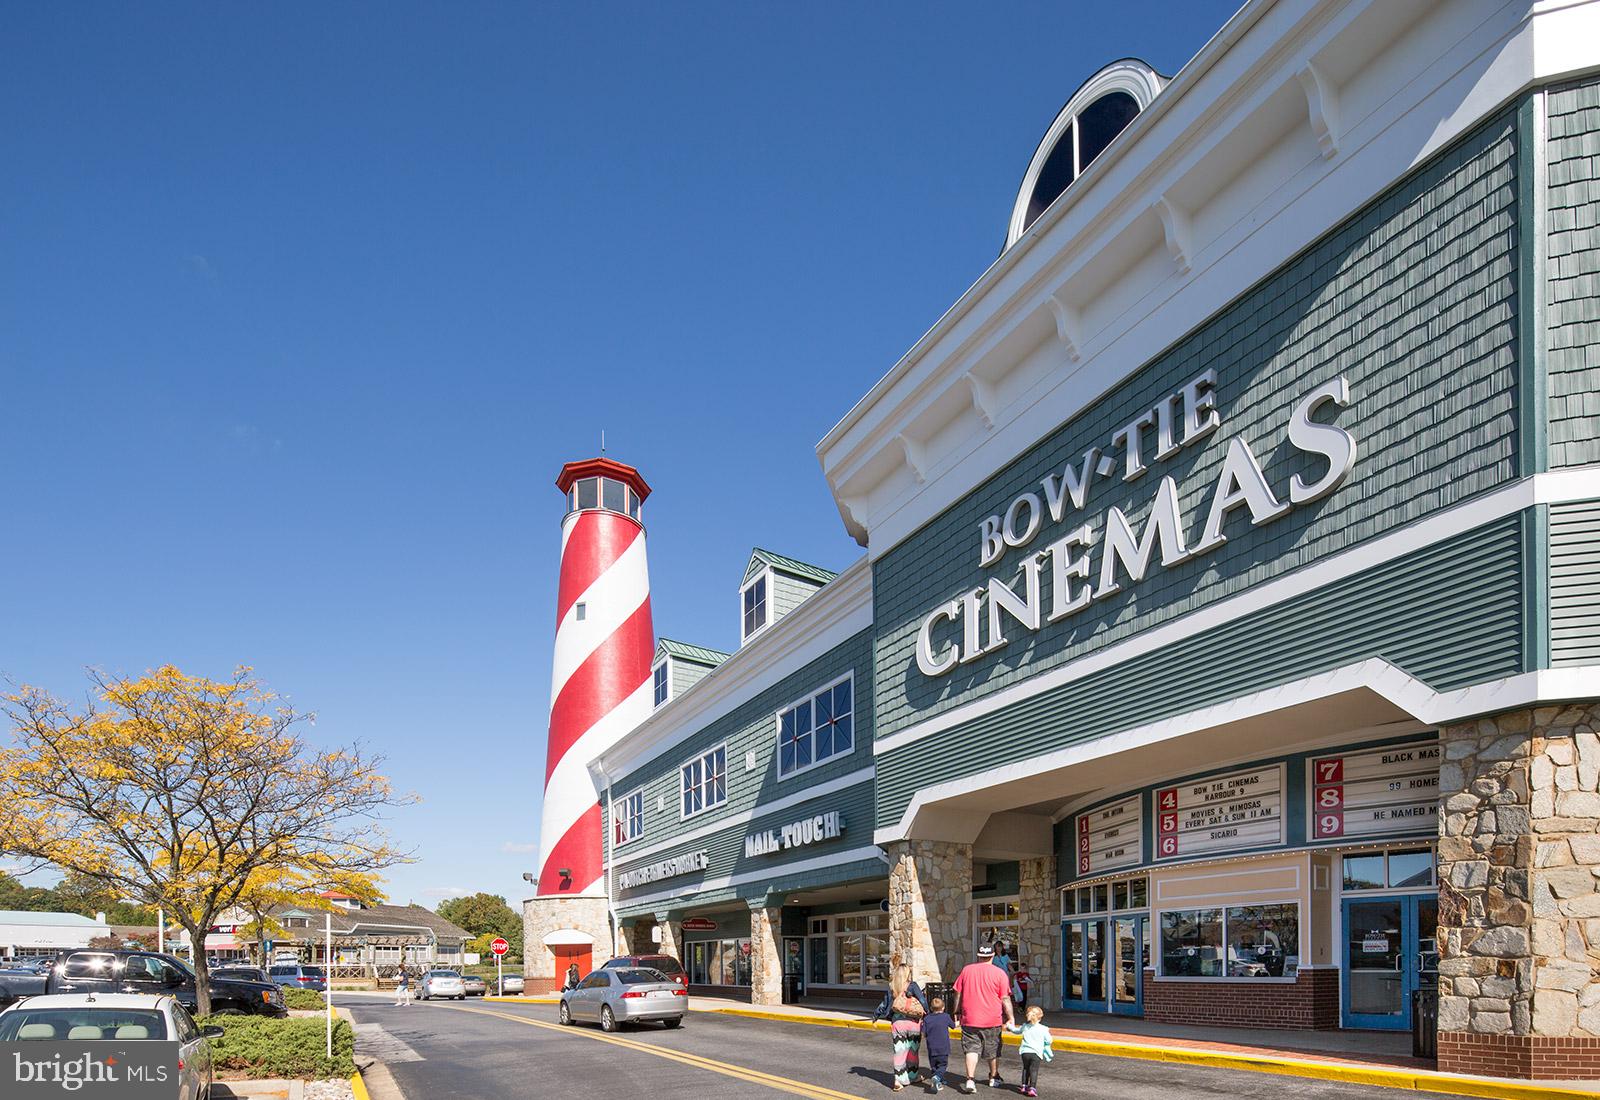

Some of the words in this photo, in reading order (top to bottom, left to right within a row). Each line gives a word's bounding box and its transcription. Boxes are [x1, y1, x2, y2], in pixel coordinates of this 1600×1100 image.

[915, 375, 1357, 677] CINEMAS
[1382, 752, 1413, 764] BLACK
[1320, 761, 1339, 780] 7
[1194, 786, 1207, 795] BOW
[1212, 783, 1223, 792] TIE
[1228, 776, 1259, 788] CINEMAS
[1389, 782, 1401, 791] 99
[1162, 792, 1175, 808] 4
[1205, 791, 1235, 801] HARBOUR
[1320, 789, 1340, 807] 8
[1191, 808, 1215, 819] MOVIES
[1229, 800, 1261, 813] MIMOSAS
[1374, 811, 1385, 820] HE
[1391, 807, 1425, 818] NAMED
[1163, 816, 1175, 831] 5
[1185, 818, 1205, 828] EVERY
[1209, 816, 1221, 824] SAT
[1232, 812, 1245, 821] SUN
[1260, 808, 1271, 816] AM
[1320, 816, 1340, 834] 9
[1081, 820, 1087, 832] 1
[745, 830, 779, 858] NAIL
[781, 811, 840, 849] TOUCH
[1210, 829, 1238, 840] SICARIO
[1081, 839, 1088, 851] 2
[1162, 838, 1175, 853] 6
[1081, 858, 1088, 871] 3
